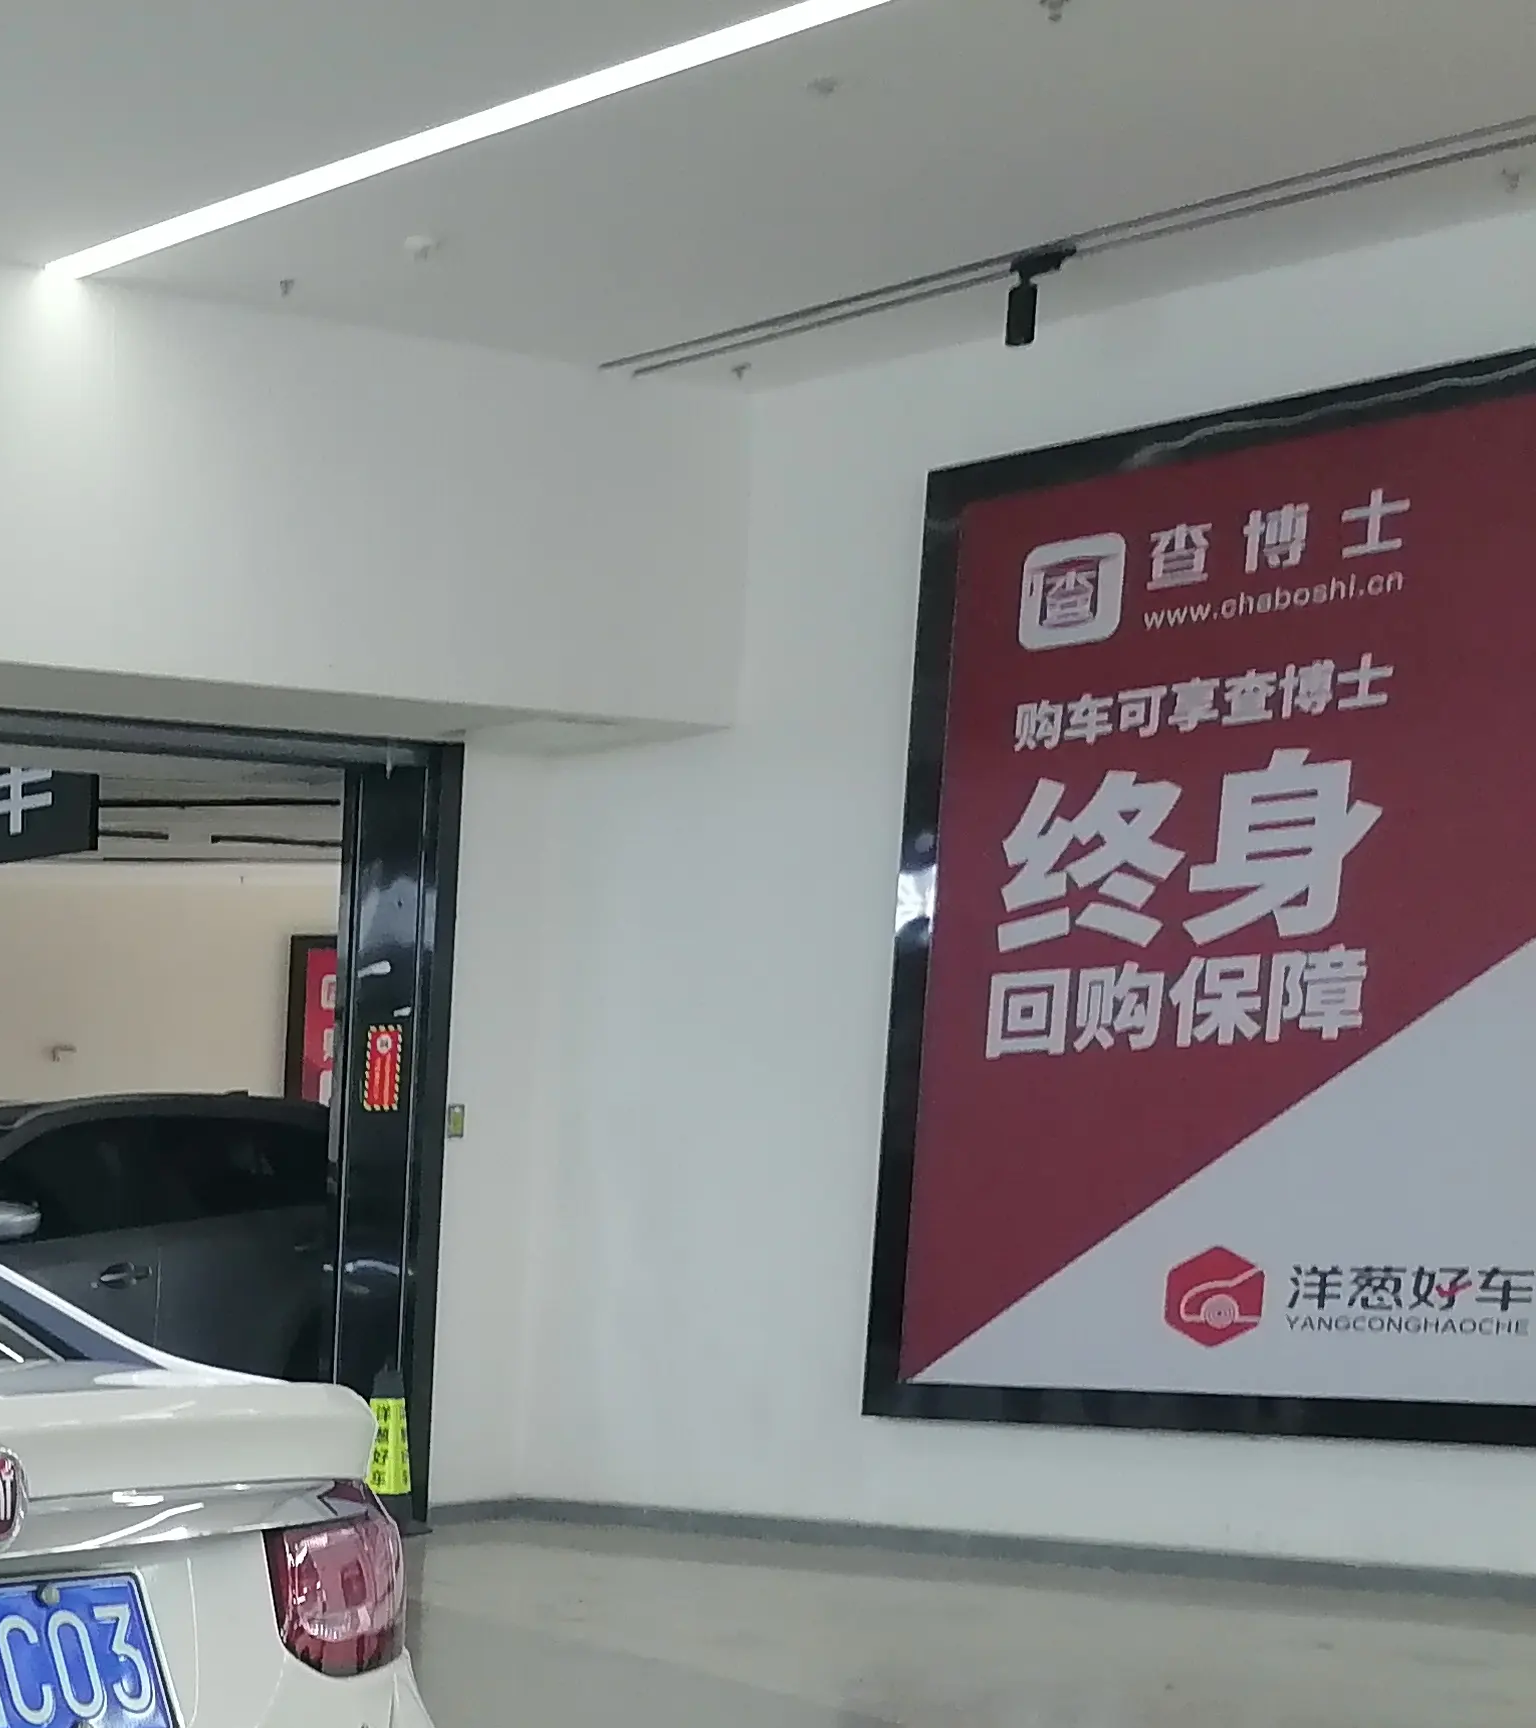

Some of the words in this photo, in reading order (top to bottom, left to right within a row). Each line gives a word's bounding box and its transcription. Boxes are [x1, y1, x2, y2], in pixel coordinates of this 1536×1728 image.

[1147, 488, 1410, 591] 查博士
[1144, 569, 1404, 631] www.chaboshi.cn
[1014, 653, 1394, 752] 购车可享查博士
[997, 748, 1383, 952] 终身
[985, 944, 1367, 1059] 回购保障
[1285, 1313, 1530, 1337] YANGCONGHAOCHE
[1288, 1264, 1534, 1311] 洋葱好车
